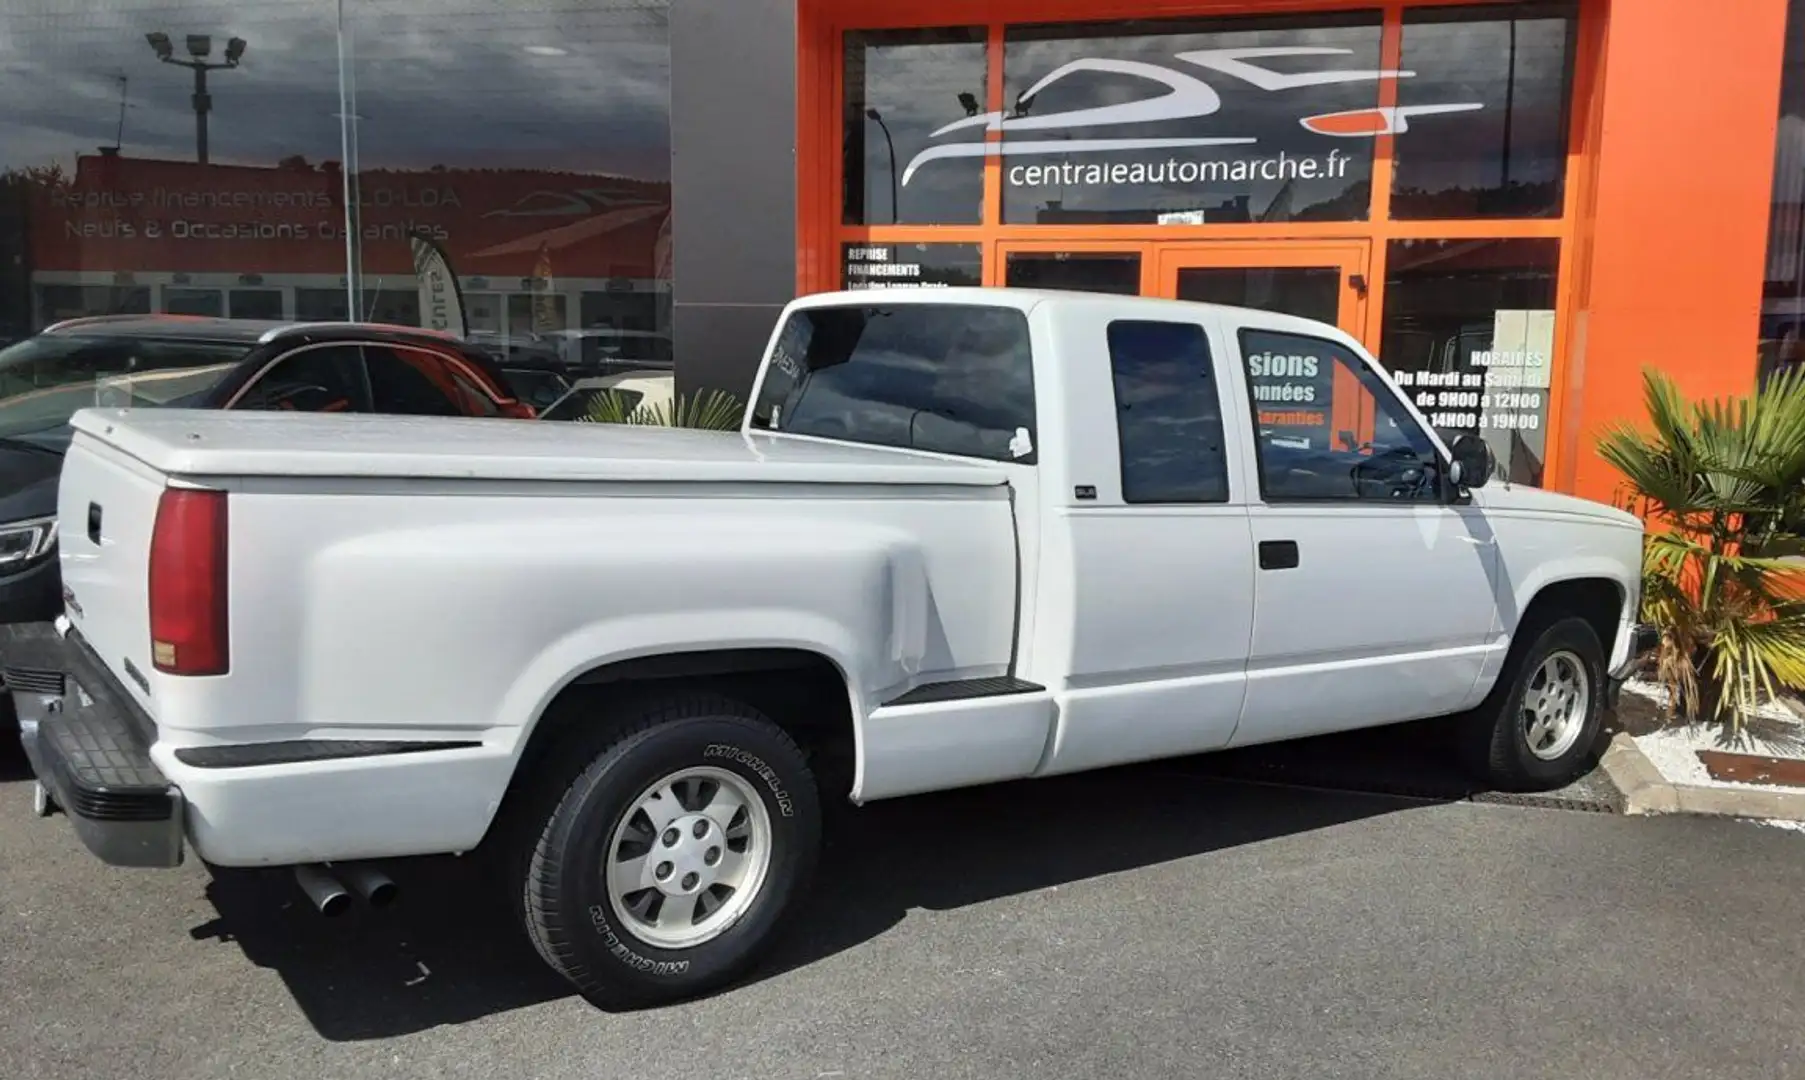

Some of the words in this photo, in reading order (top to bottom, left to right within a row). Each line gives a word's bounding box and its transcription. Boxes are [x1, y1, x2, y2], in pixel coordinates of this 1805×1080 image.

[1009, 149, 1351, 186] centraleautomarche.fr
[64, 218, 137, 239] Neufs
[145, 219, 163, 238] &
[171, 218, 306, 239] Occasions
[848, 247, 888, 260] REPRISE
[848, 264, 920, 276] FINANCEMENTS
[1416, 371, 1460, 387] Mardi
[1463, 373, 1481, 386] au
[1416, 391, 1435, 406] de
[1438, 392, 1478, 407] 9H00
[1495, 393, 1541, 408] 12H00
[1431, 412, 1476, 427] 14H00
[1492, 414, 1539, 429] 19H00
[704, 743, 793, 817] MICHELIN
[588, 904, 691, 976] MICHELIN
